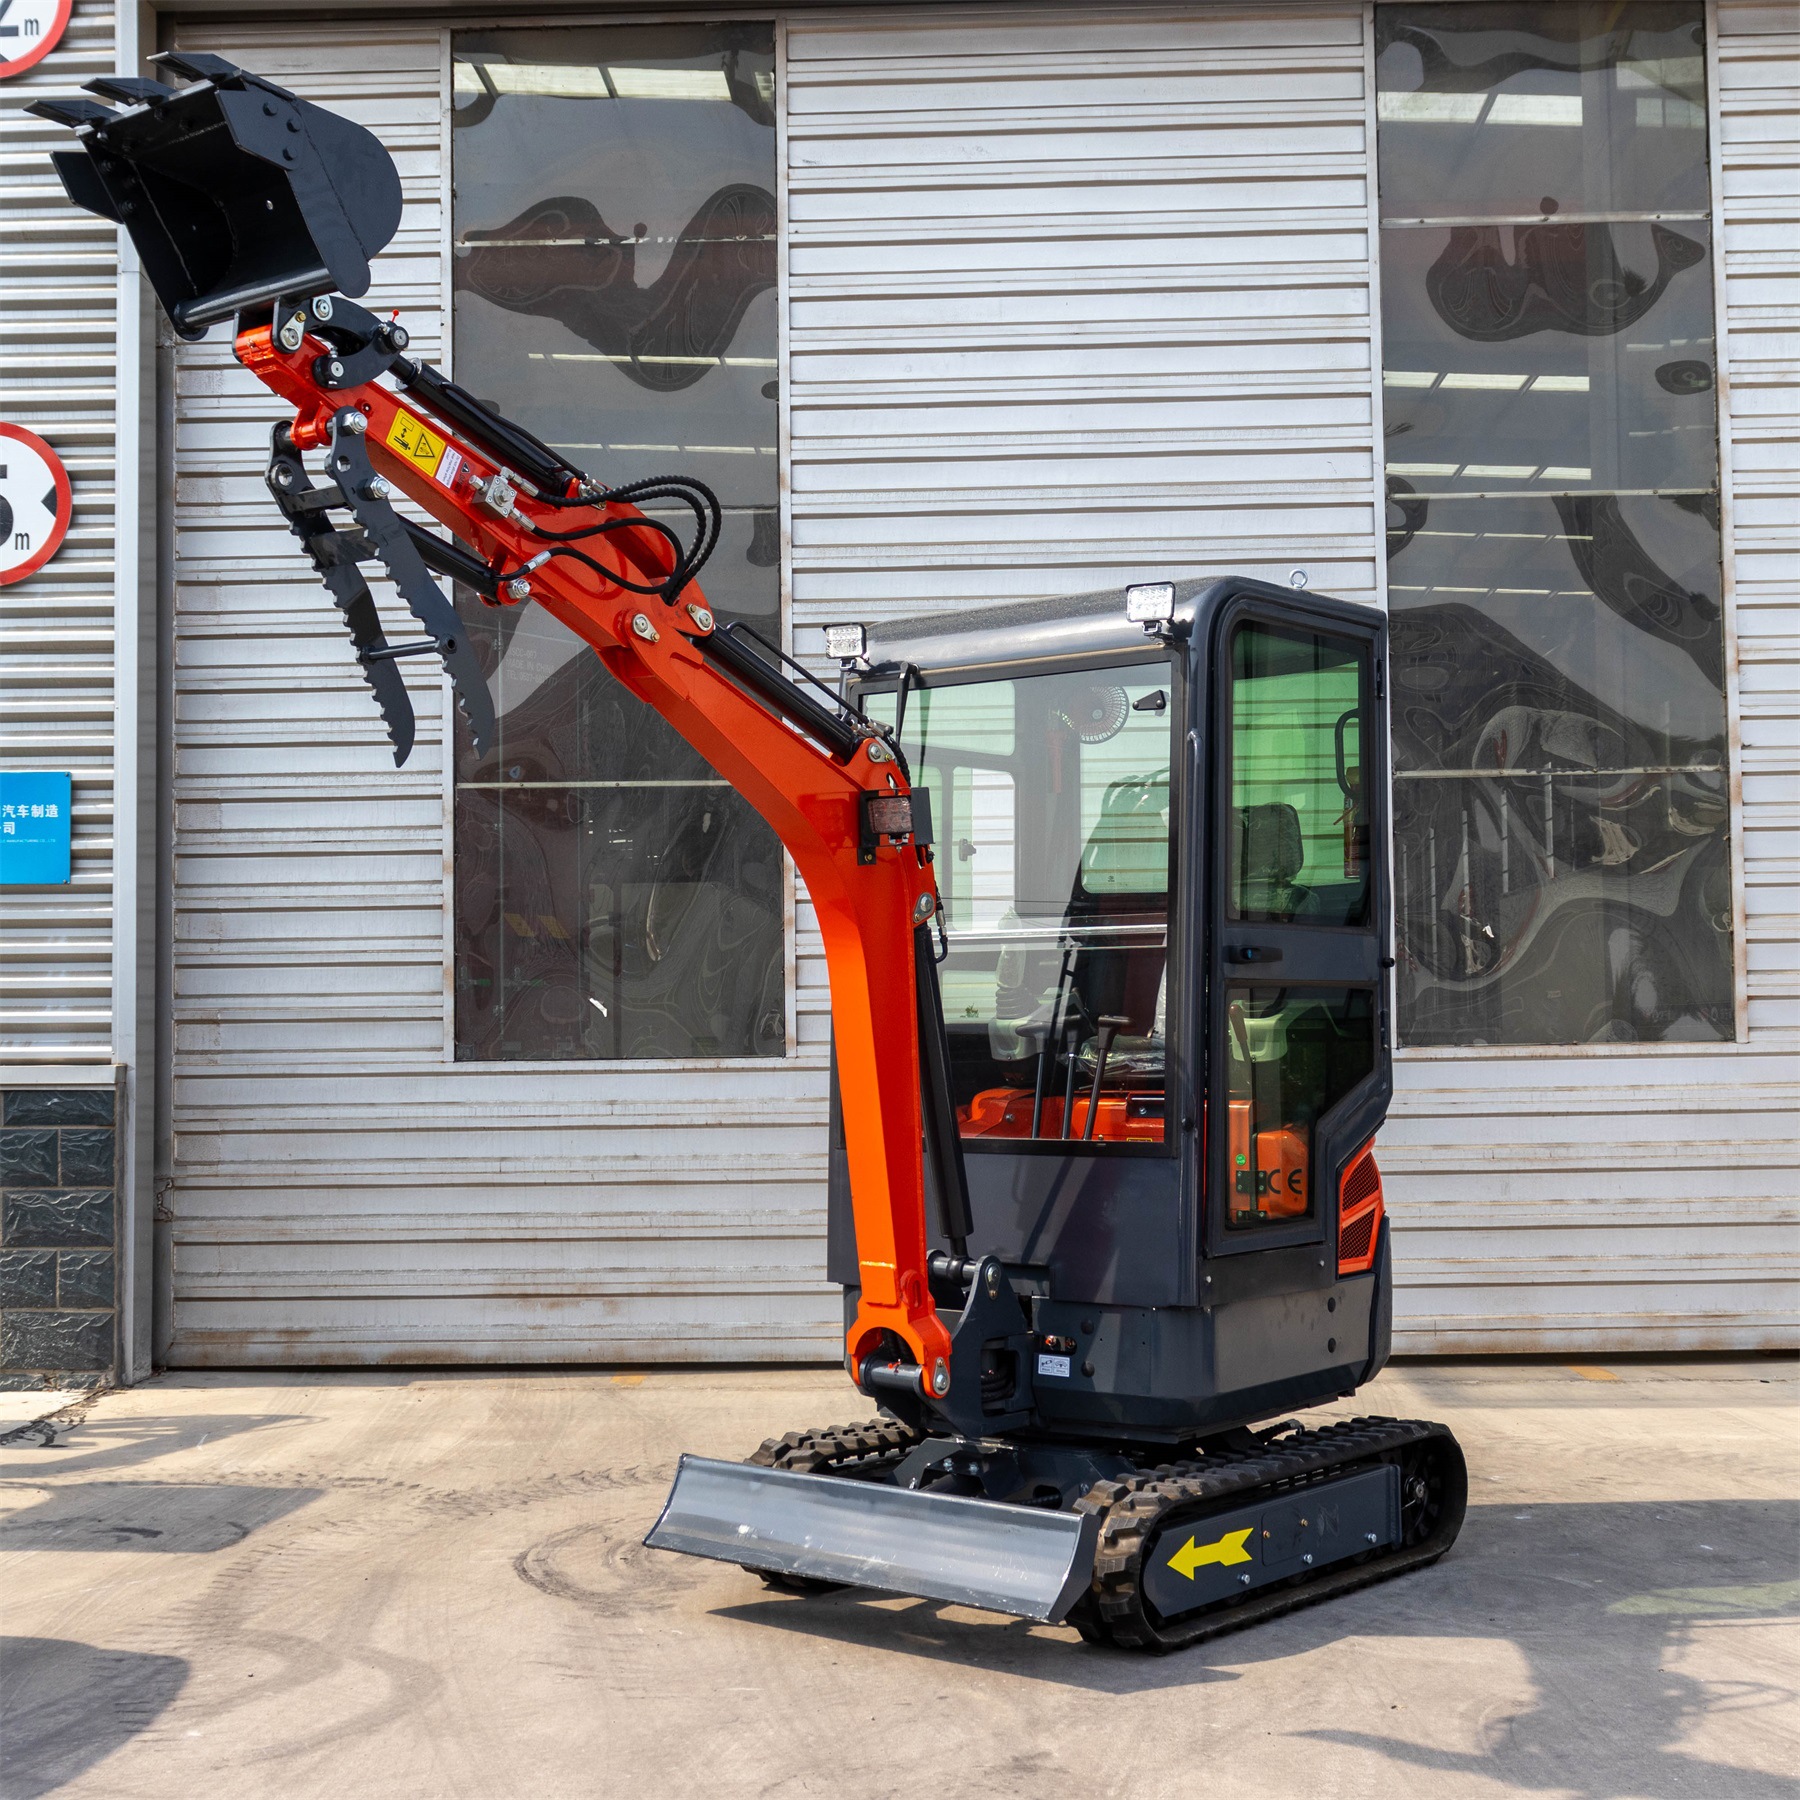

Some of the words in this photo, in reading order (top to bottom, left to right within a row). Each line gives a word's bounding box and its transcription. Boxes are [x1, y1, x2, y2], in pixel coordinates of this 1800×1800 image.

[2, 804, 58, 818] 汽车制造
[1267, 1168, 1303, 1194] CE
